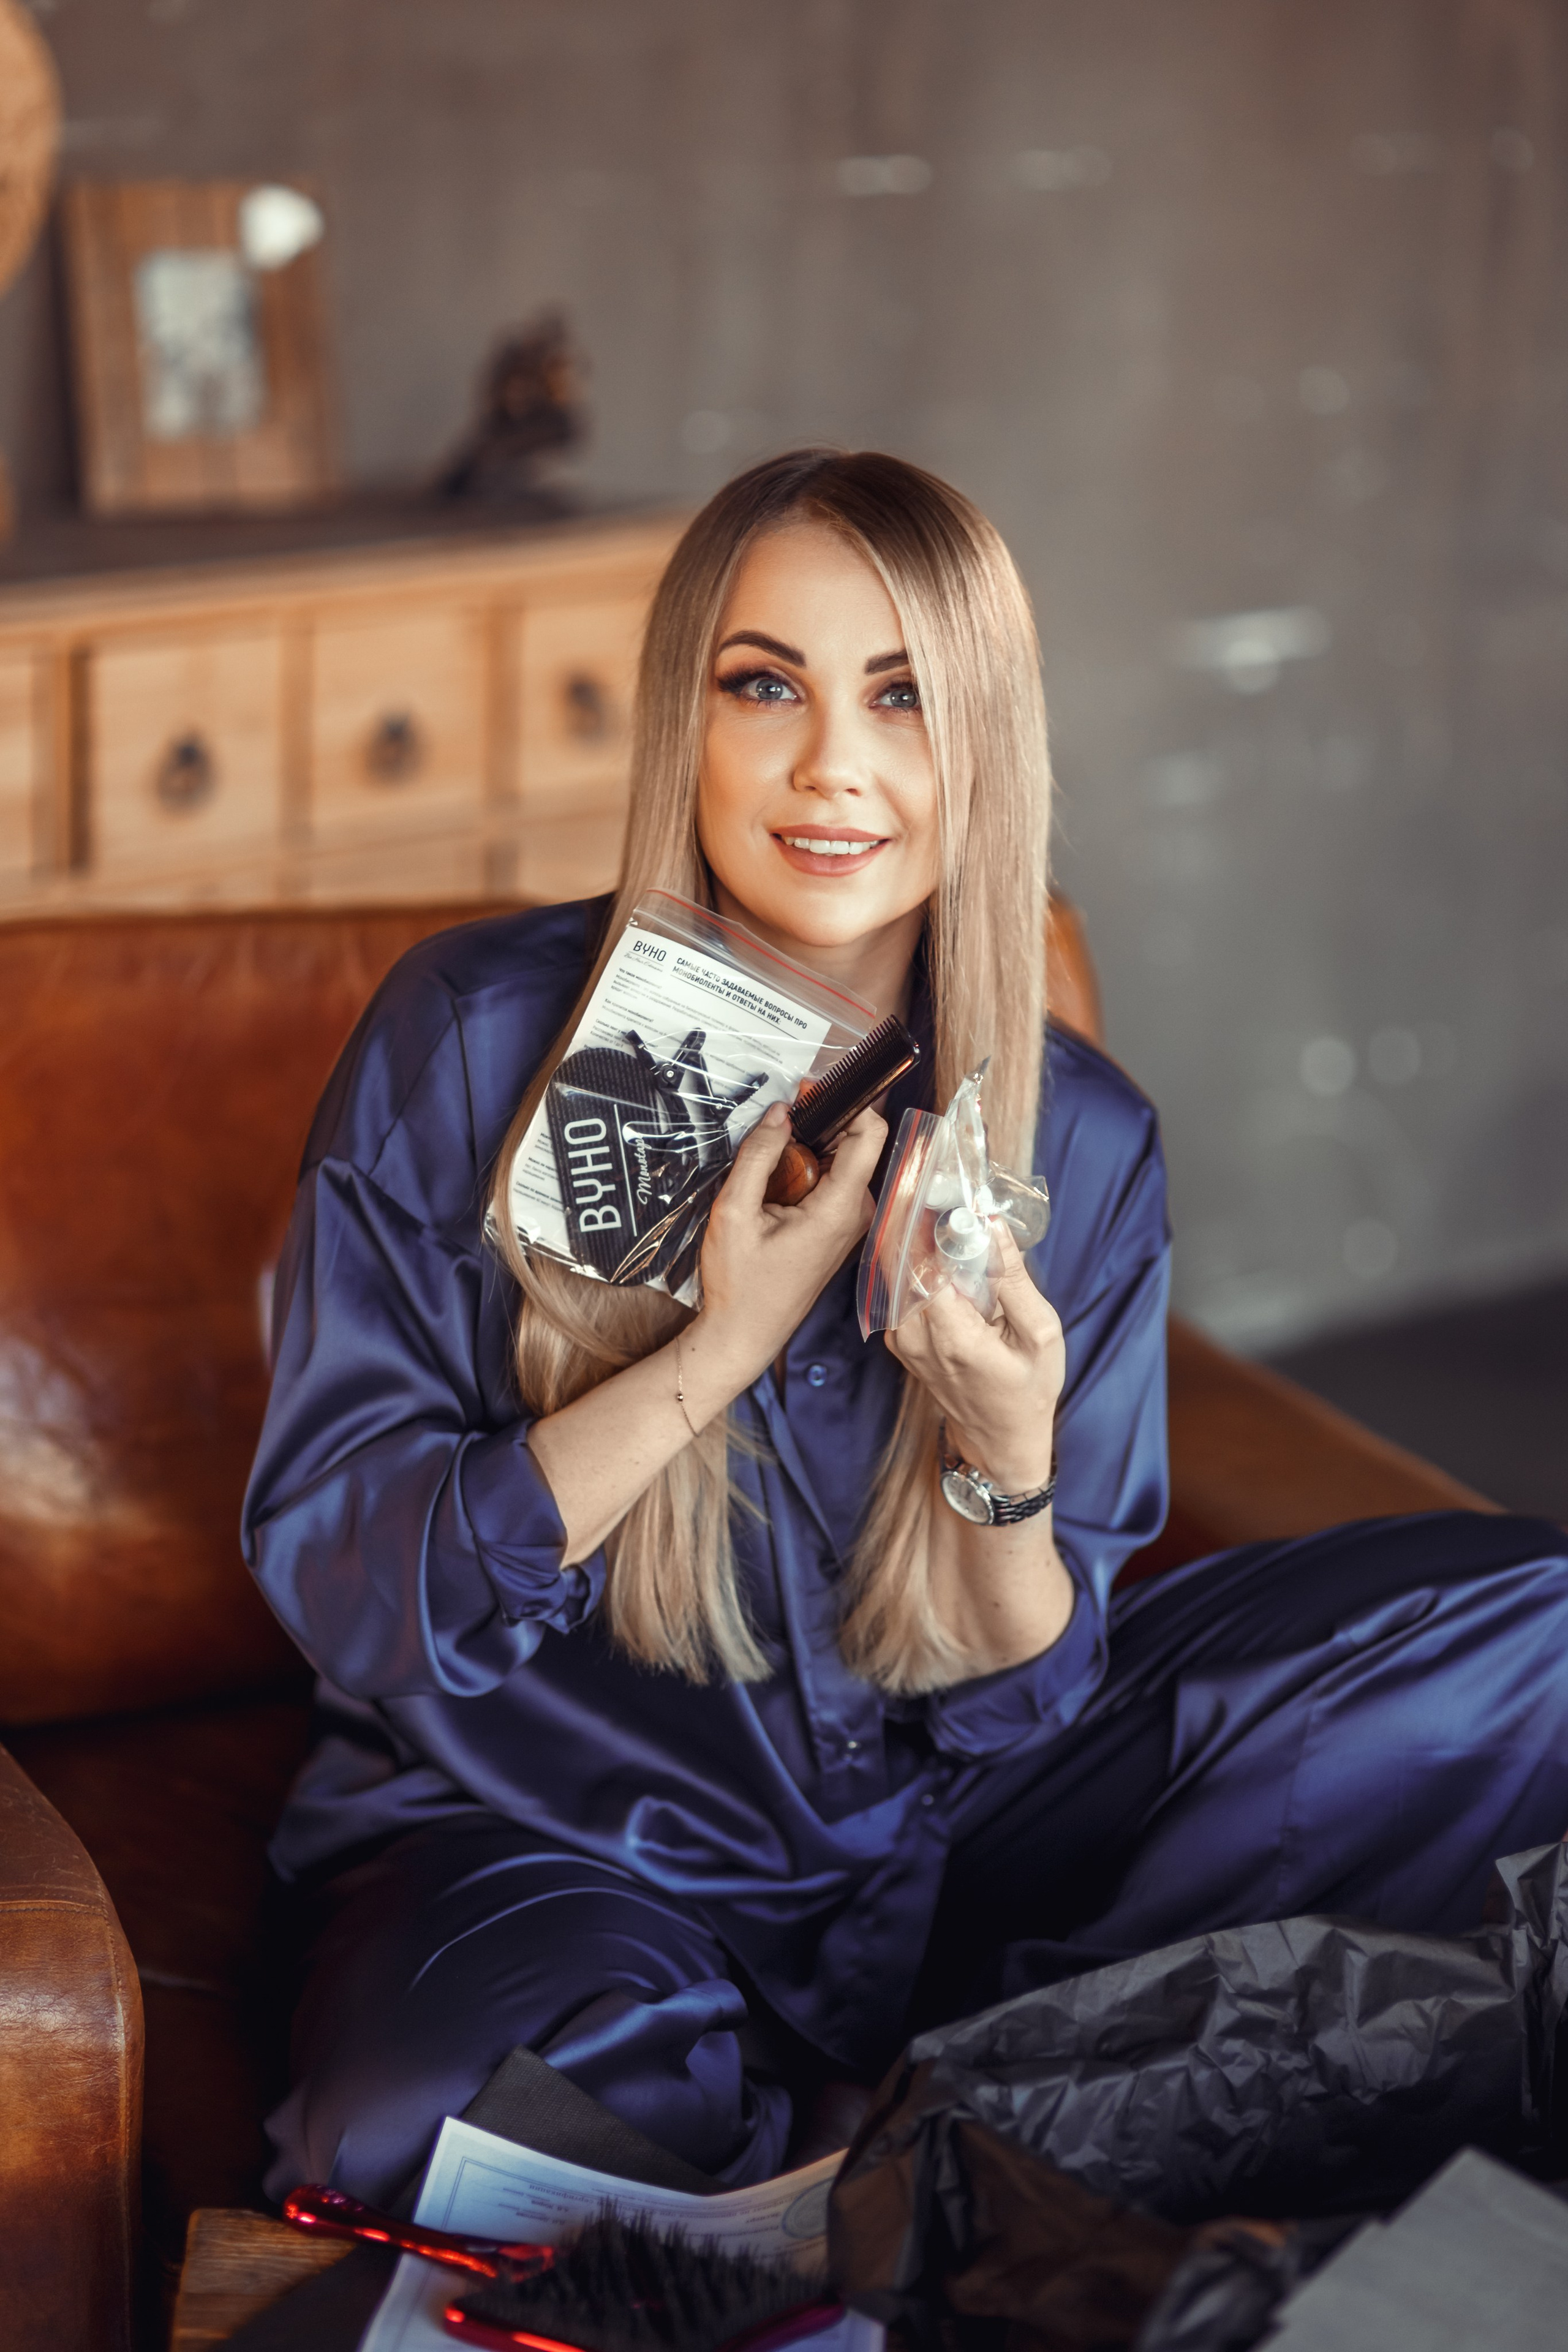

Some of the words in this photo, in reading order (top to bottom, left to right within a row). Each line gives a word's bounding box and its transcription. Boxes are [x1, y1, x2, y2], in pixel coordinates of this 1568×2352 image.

[633, 940, 666, 962] BYHO
[673, 966, 725, 995] МОНОБИОЛЕНТЫ
[732, 994, 757, 1011] ОТВЕТЫ
[757, 1007, 766, 1016] НА
[766, 1012, 780, 1025] НИХ:
[677, 957, 700, 973] САМЫЕ
[701, 969, 720, 982] ЧАСТО
[721, 979, 764, 1005] ЗАДАВАЕМЫЕ
[764, 1001, 794, 1022] ВОПРОСЫ
[794, 1017, 807, 1029] ПРО
[565, 1118, 622, 1234] BYHO
[637, 1131, 650, 1205] Monotap
